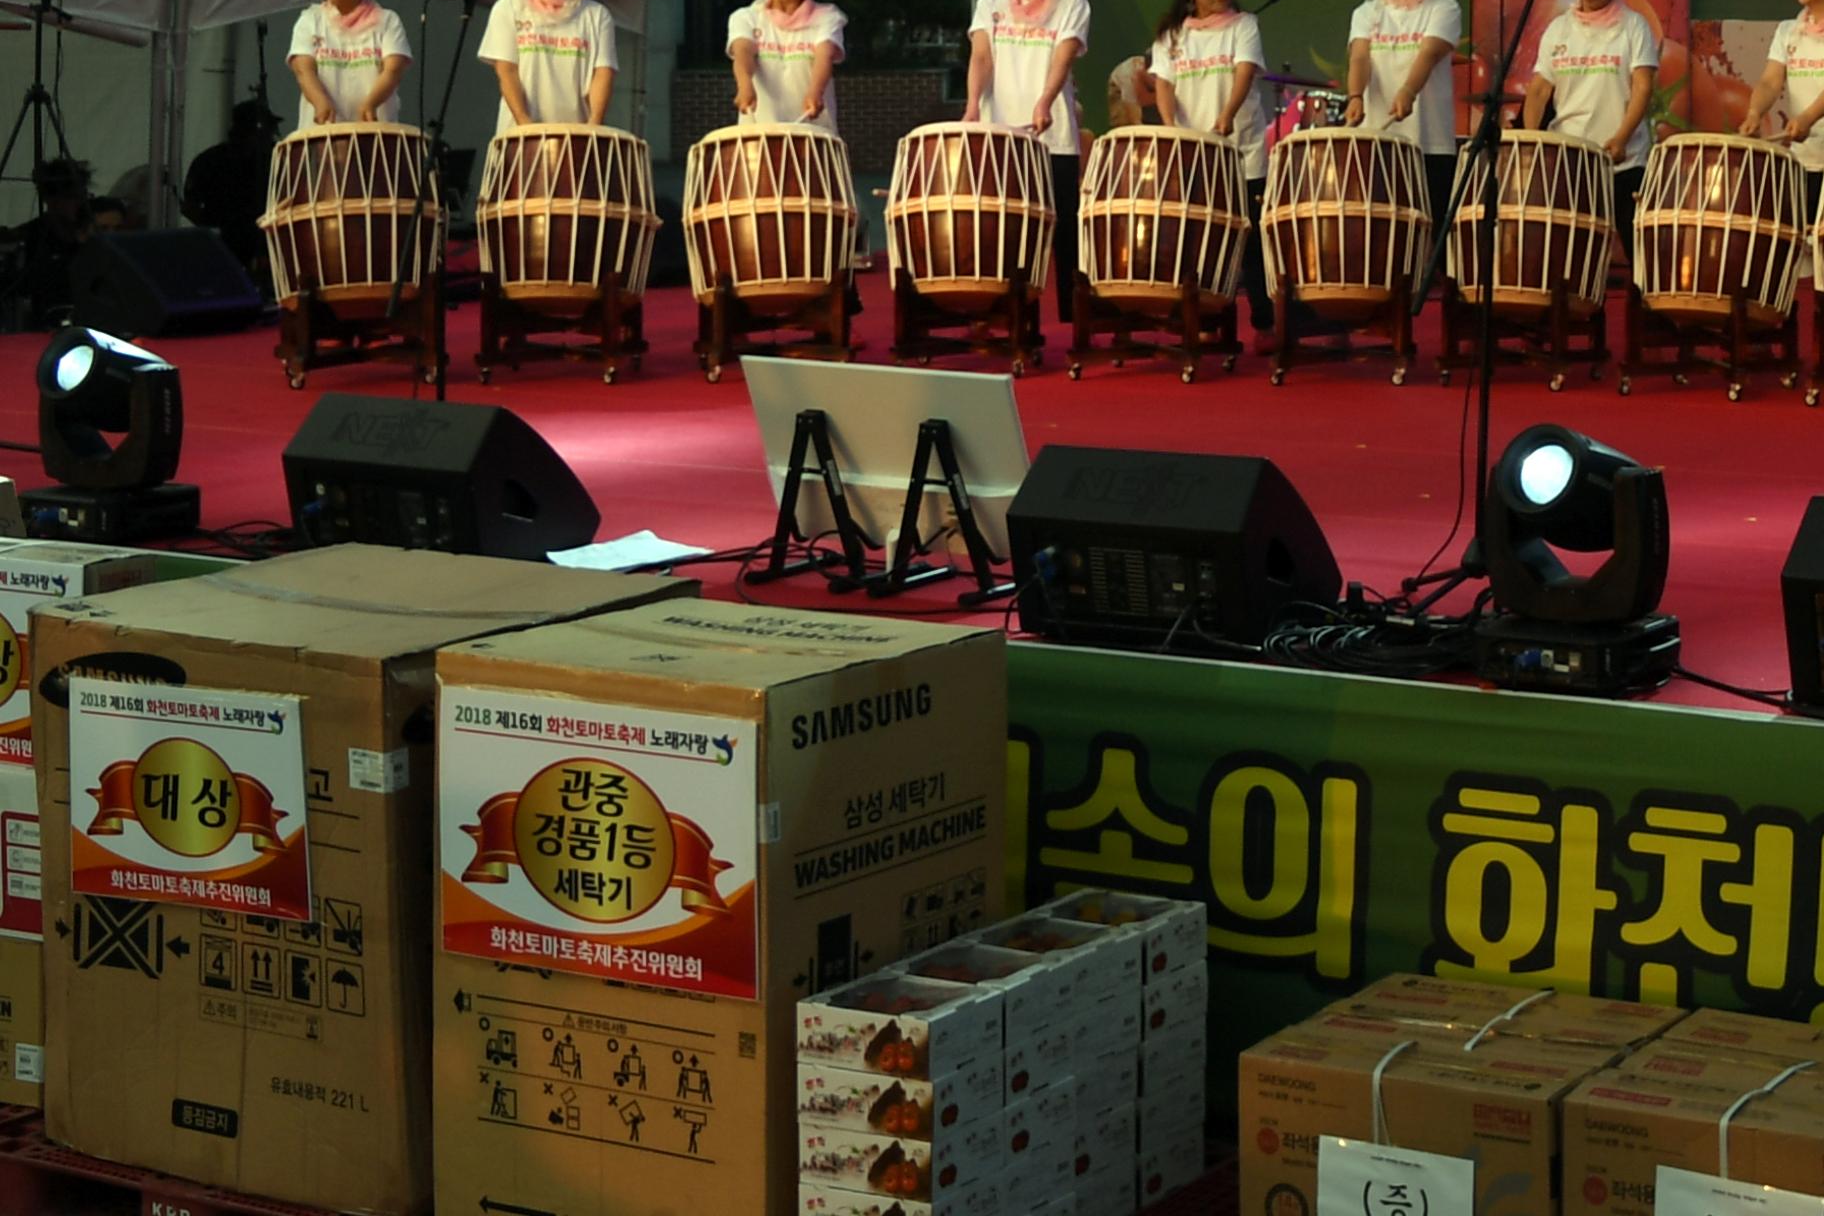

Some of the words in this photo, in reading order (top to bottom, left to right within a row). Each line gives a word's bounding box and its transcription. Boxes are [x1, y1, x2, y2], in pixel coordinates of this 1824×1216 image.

[11, 571, 50, 591] 노래자랑
[81, 691, 108, 709] 2018
[110, 693, 144, 714] 제16회
[146, 699, 220, 721] 화천토마토축제
[222, 707, 265, 728] 노래자랑
[455, 704, 492, 726] 2018
[495, 710, 543, 733] 제16회
[546, 715, 647, 747] 화천토마토축제
[650, 728, 709, 755] 노래자랑
[792, 683, 932, 750] SAMSUNG
[141, 773, 232, 829] 대상
[558, 767, 629, 818] 관중
[845, 788, 883, 830] 삼성
[889, 772, 946, 814] 세탁기
[531, 812, 657, 870] 경품1등
[794, 835, 895, 890] WASHING
[899, 804, 987, 857] MACHINE
[110, 868, 272, 908] 화천토마토축제추진위원회
[554, 868, 633, 911] 세탁기
[490, 925, 704, 983] 화천토마토축제추진위원회
[331, 1088, 355, 1111] 221
[360, 1094, 370, 1113] L
